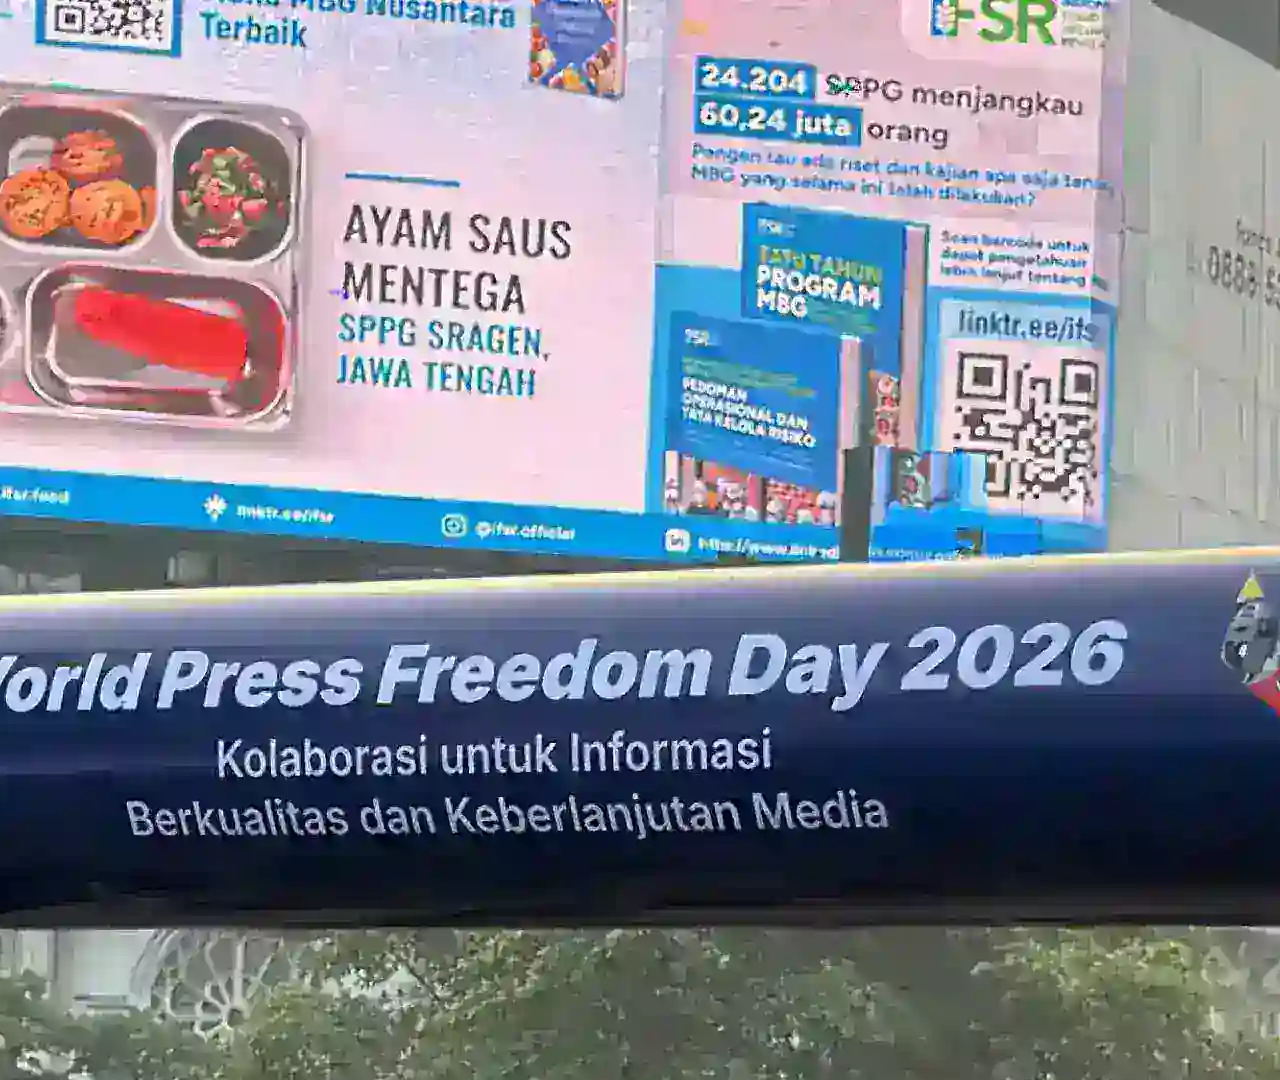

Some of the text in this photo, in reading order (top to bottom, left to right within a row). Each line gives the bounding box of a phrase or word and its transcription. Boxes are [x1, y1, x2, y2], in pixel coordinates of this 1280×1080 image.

[199, 11, 307, 48] Terbaik
[701, 62, 1084, 118] 24.204 SPPG menjangkau
[700, 101, 949, 150] 60,24 juta orang
[343, 204, 572, 260] AYAM SAUS
[342, 261, 526, 315] MENTEGA
[756, 264, 881, 310] PROGRAM
[337, 313, 551, 362] SPPG SRAGEN,
[336, 353, 536, 400] JAWA TENGAH
[157, 650, 364, 709] Press
[376, 638, 713, 704] Freedom
[727, 633, 890, 712] Day
[901, 620, 1128, 691] 2026
[218, 727, 773, 779] Kolaborasi untuk Informasi
[126, 789, 889, 840] Berkualitas dan Keberlanjutan Media
